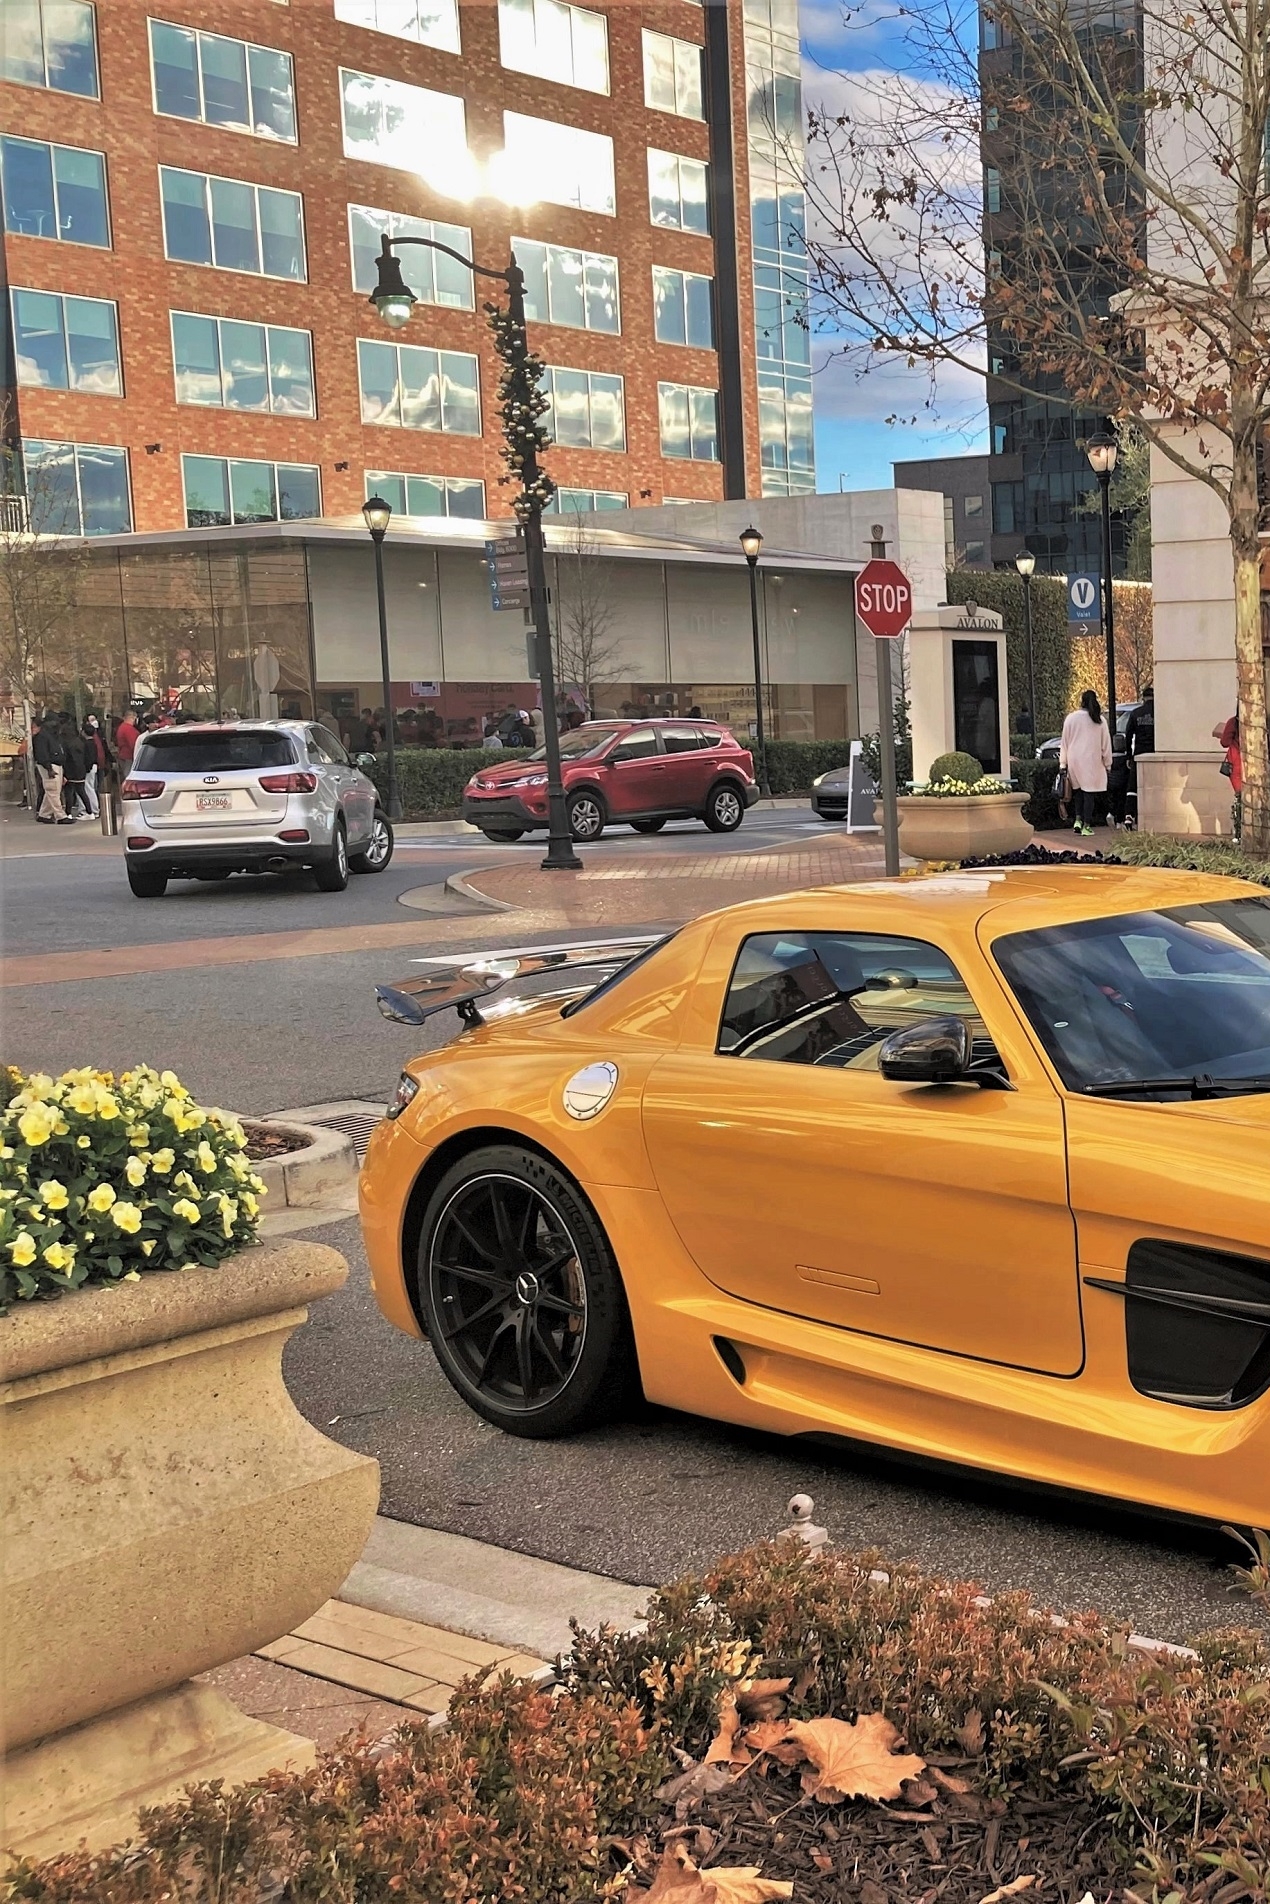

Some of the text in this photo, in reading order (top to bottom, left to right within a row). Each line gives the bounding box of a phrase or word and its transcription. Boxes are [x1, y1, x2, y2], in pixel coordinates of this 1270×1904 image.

[860, 583, 909, 613] STOP
[1077, 582, 1089, 604] V
[956, 617, 999, 629] AVALON
